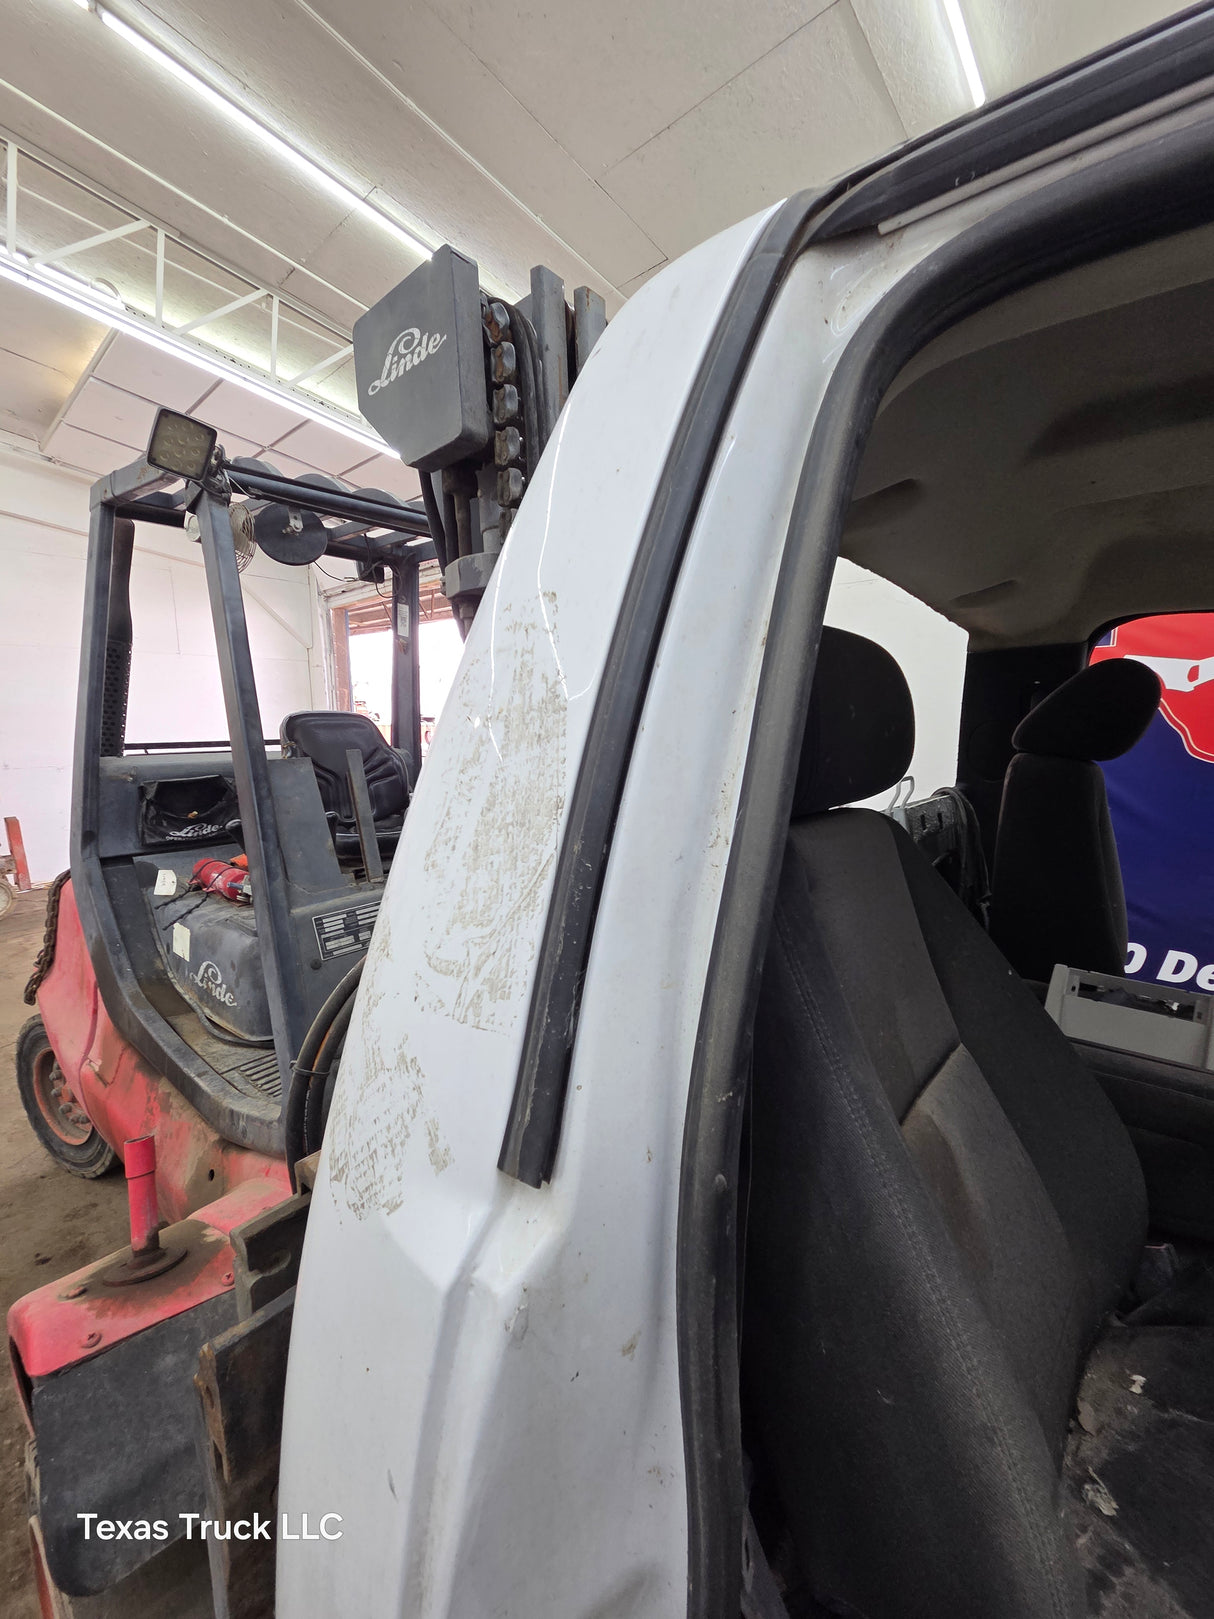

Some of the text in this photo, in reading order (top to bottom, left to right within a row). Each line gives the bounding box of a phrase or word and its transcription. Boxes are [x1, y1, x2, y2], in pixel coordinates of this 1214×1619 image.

[367, 327, 447, 396] Linde
[169, 823, 223, 837] Linde
[190, 960, 238, 1007] Linde
